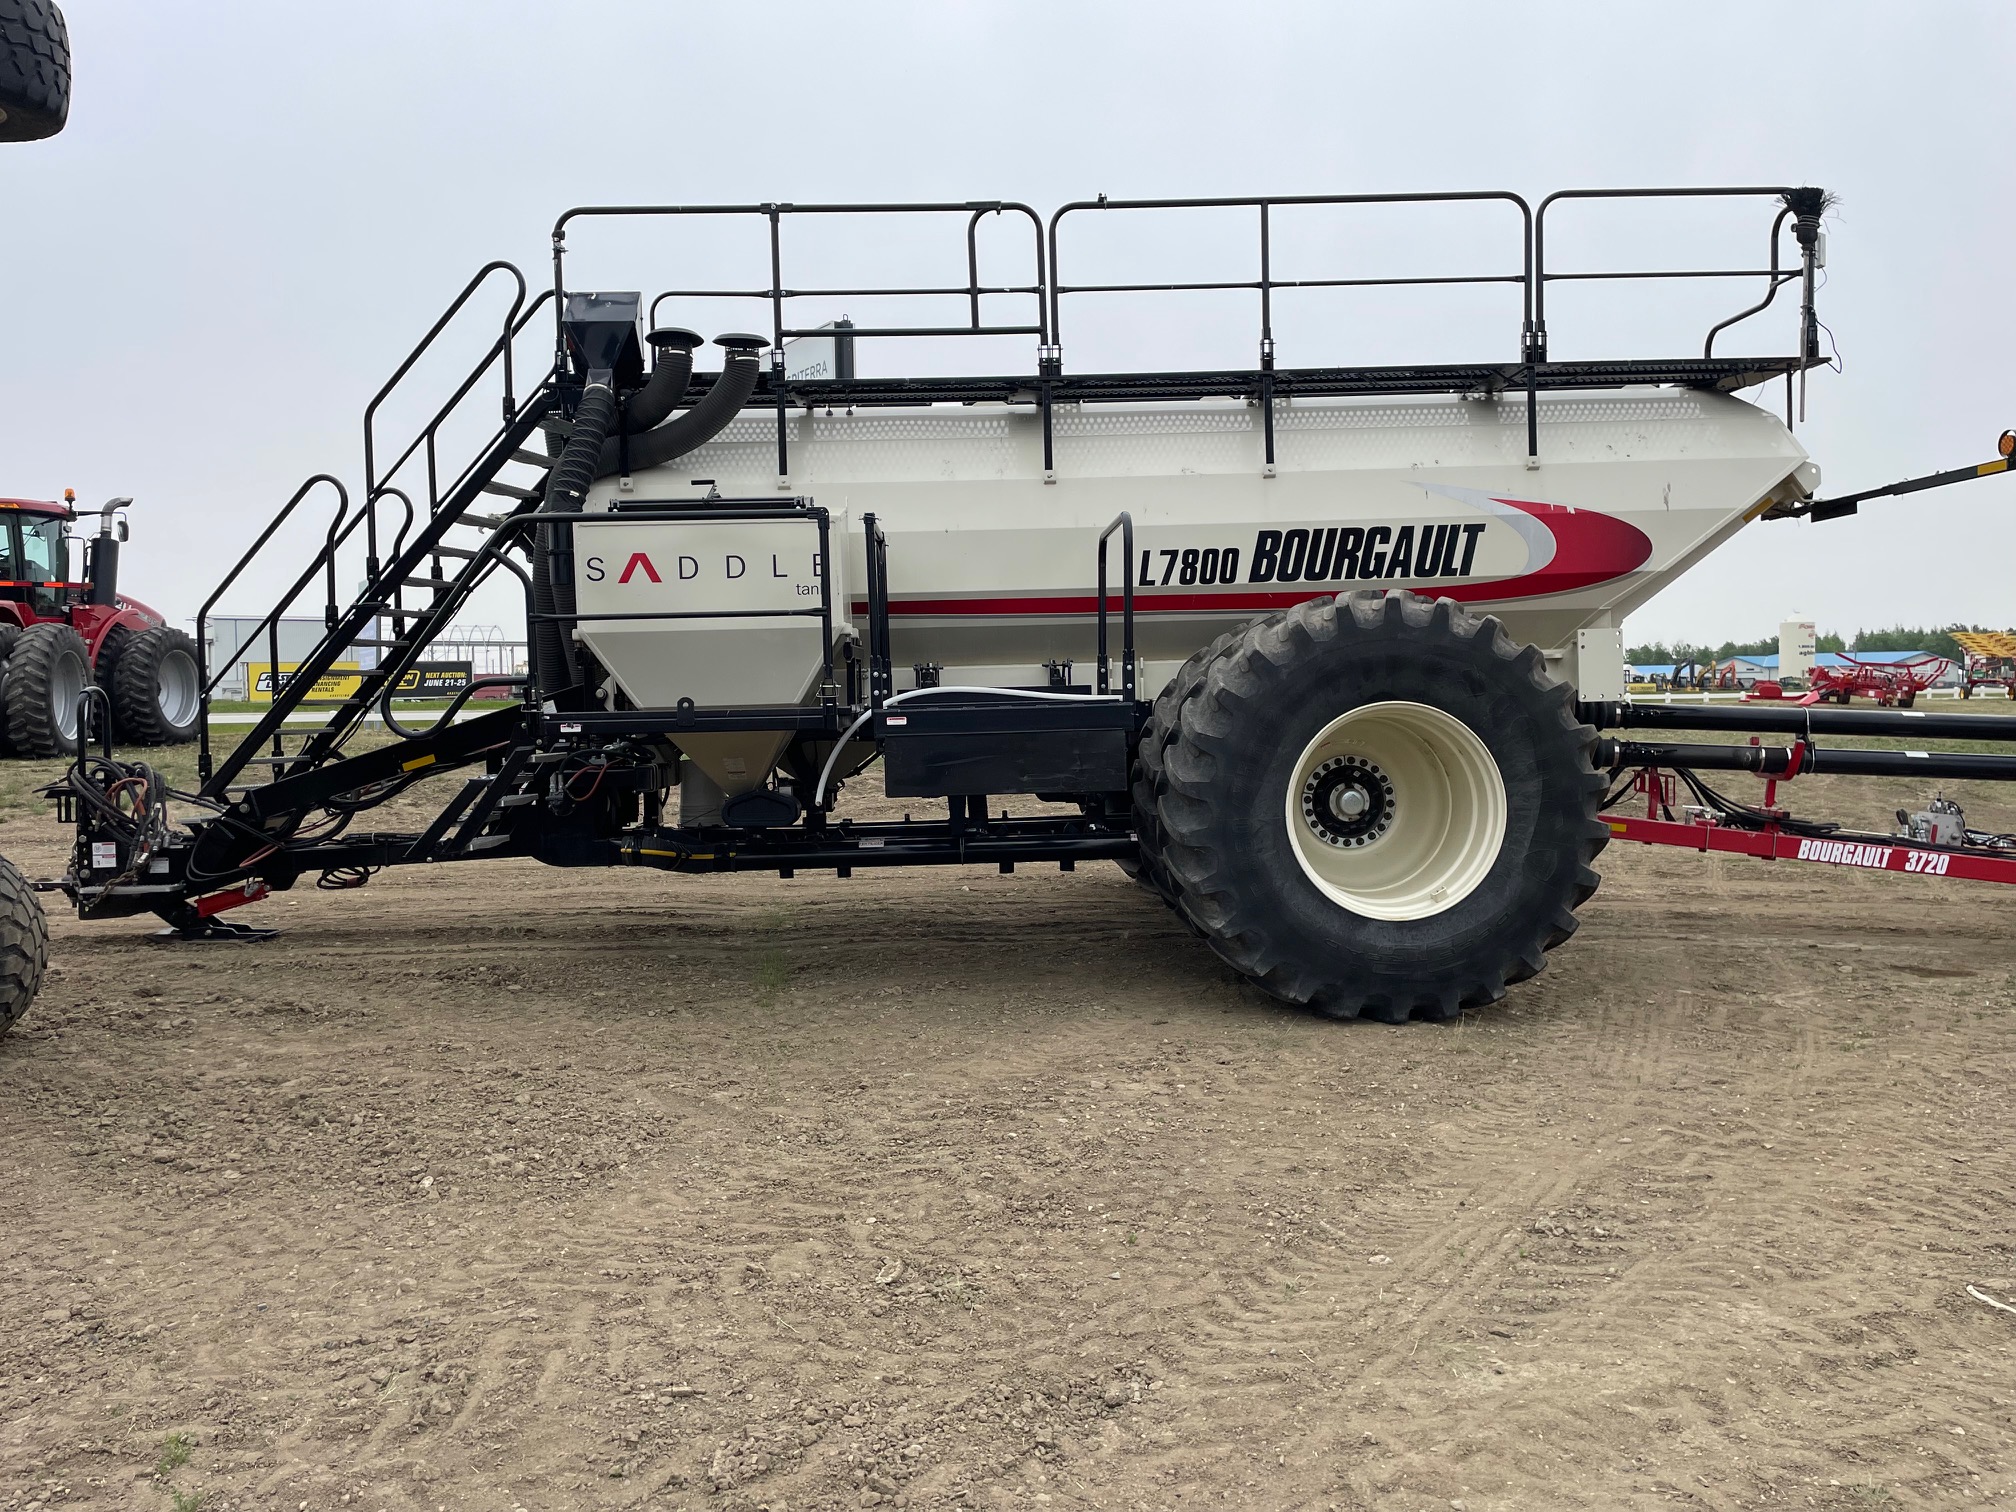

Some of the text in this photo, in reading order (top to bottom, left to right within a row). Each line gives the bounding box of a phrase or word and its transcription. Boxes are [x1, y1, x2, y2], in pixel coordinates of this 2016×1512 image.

[1138, 523, 1487, 587] L7800 BOURGAULT
[423, 679, 467, 687] JUNE 21-25
[1797, 839, 1950, 875] BOURGAULT 3720
